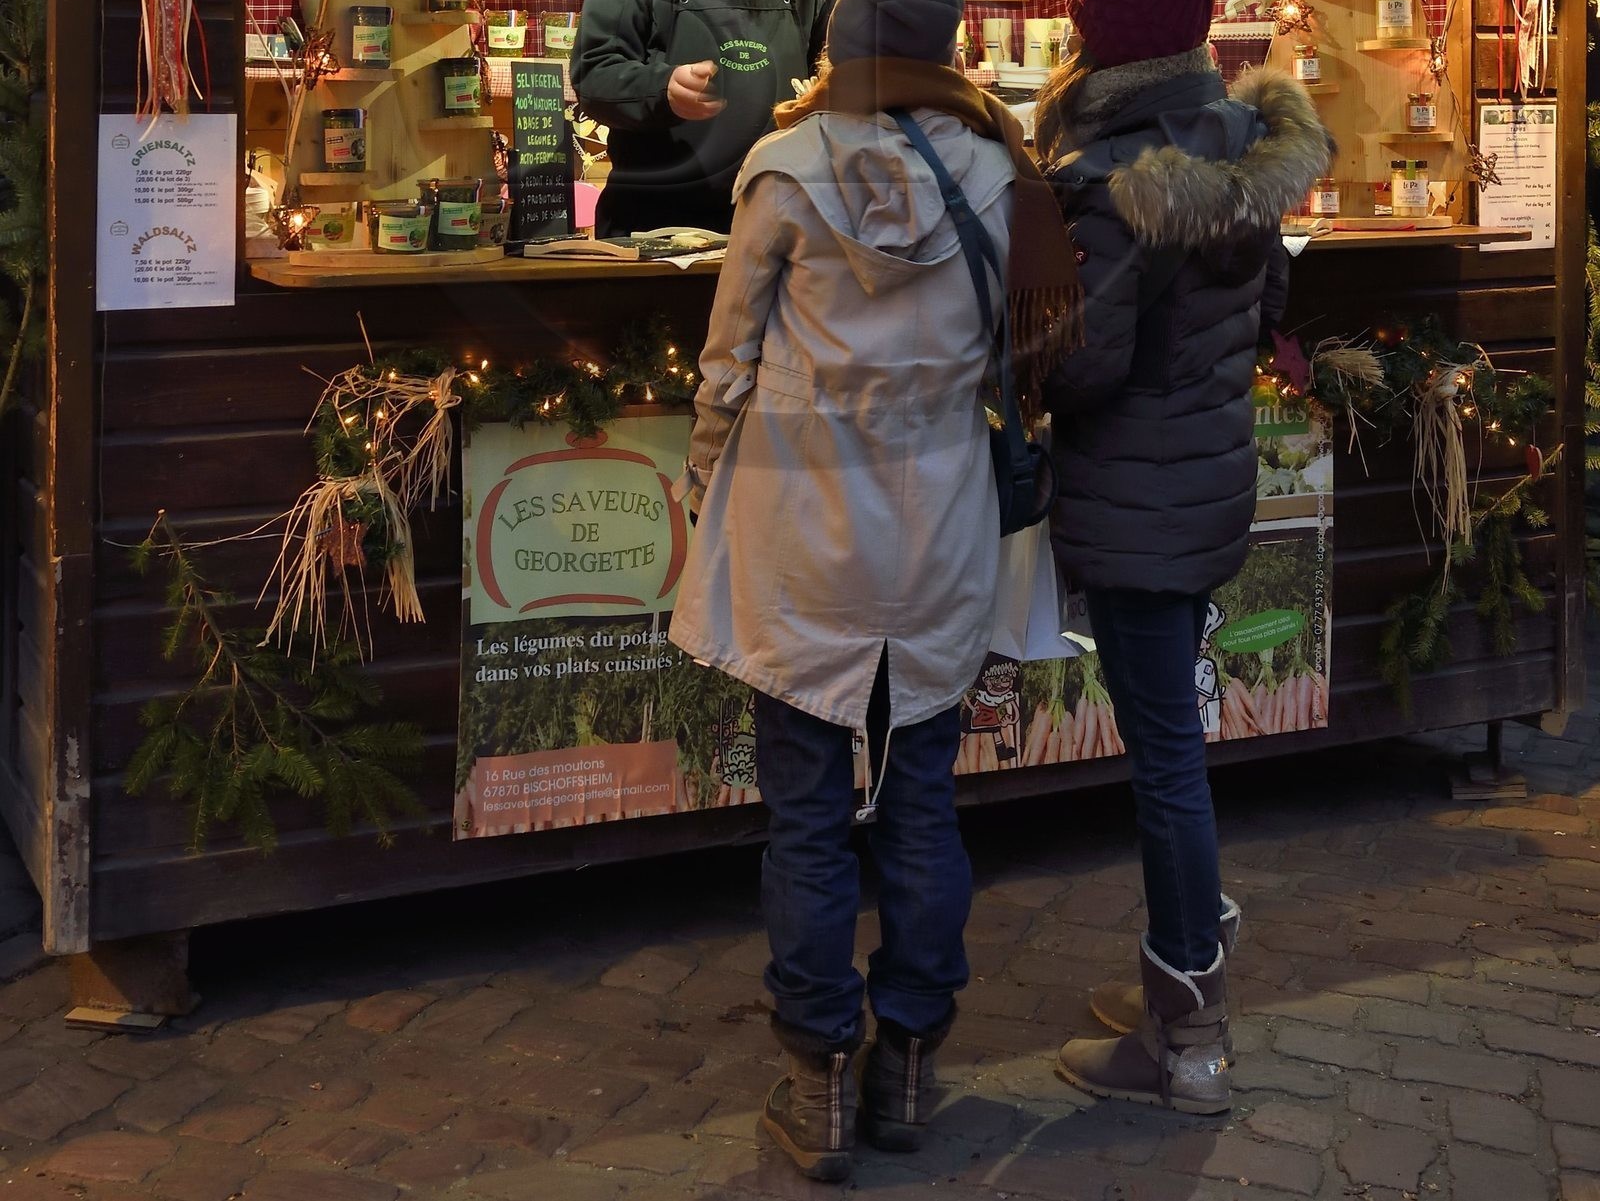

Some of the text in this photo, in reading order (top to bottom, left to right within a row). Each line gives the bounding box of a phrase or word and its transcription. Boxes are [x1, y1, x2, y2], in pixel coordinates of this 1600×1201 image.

[720, 40, 767, 52] LES SAVEURS
[720, 57, 769, 71] GEORGETTE
[516, 74, 562, 88] SEL VEGETAL
[533, 98, 562, 112] NATUREL
[542, 117, 553, 129] DE
[527, 134, 558, 146] LEGUMES
[131, 140, 196, 167] GRIENSALTZ
[131, 226, 197, 255] WALDSALTZ
[1254, 399, 1307, 425] ntes
[498, 490, 664, 532] LES SAVEURS
[571, 523, 600, 542] DE
[514, 542, 655, 573] GEORGETTE
[1315, 570, 1324, 580] 73
[1315, 584, 1323, 595] 92
[1315, 597, 1323, 608] 93
[1314, 610, 1322, 621] 77
[1314, 624, 1322, 635] 07
[476, 629, 668, 656] Les légumes du potag
[475, 650, 683, 683] dans vos plats cuisinés !
[485, 759, 605, 783] 16 Rue des moutons
[483, 773, 613, 798] 67870 BISCHOFFSHEIM
[483, 782, 670, 813] lessaveursdegeorgette@gmail.com
